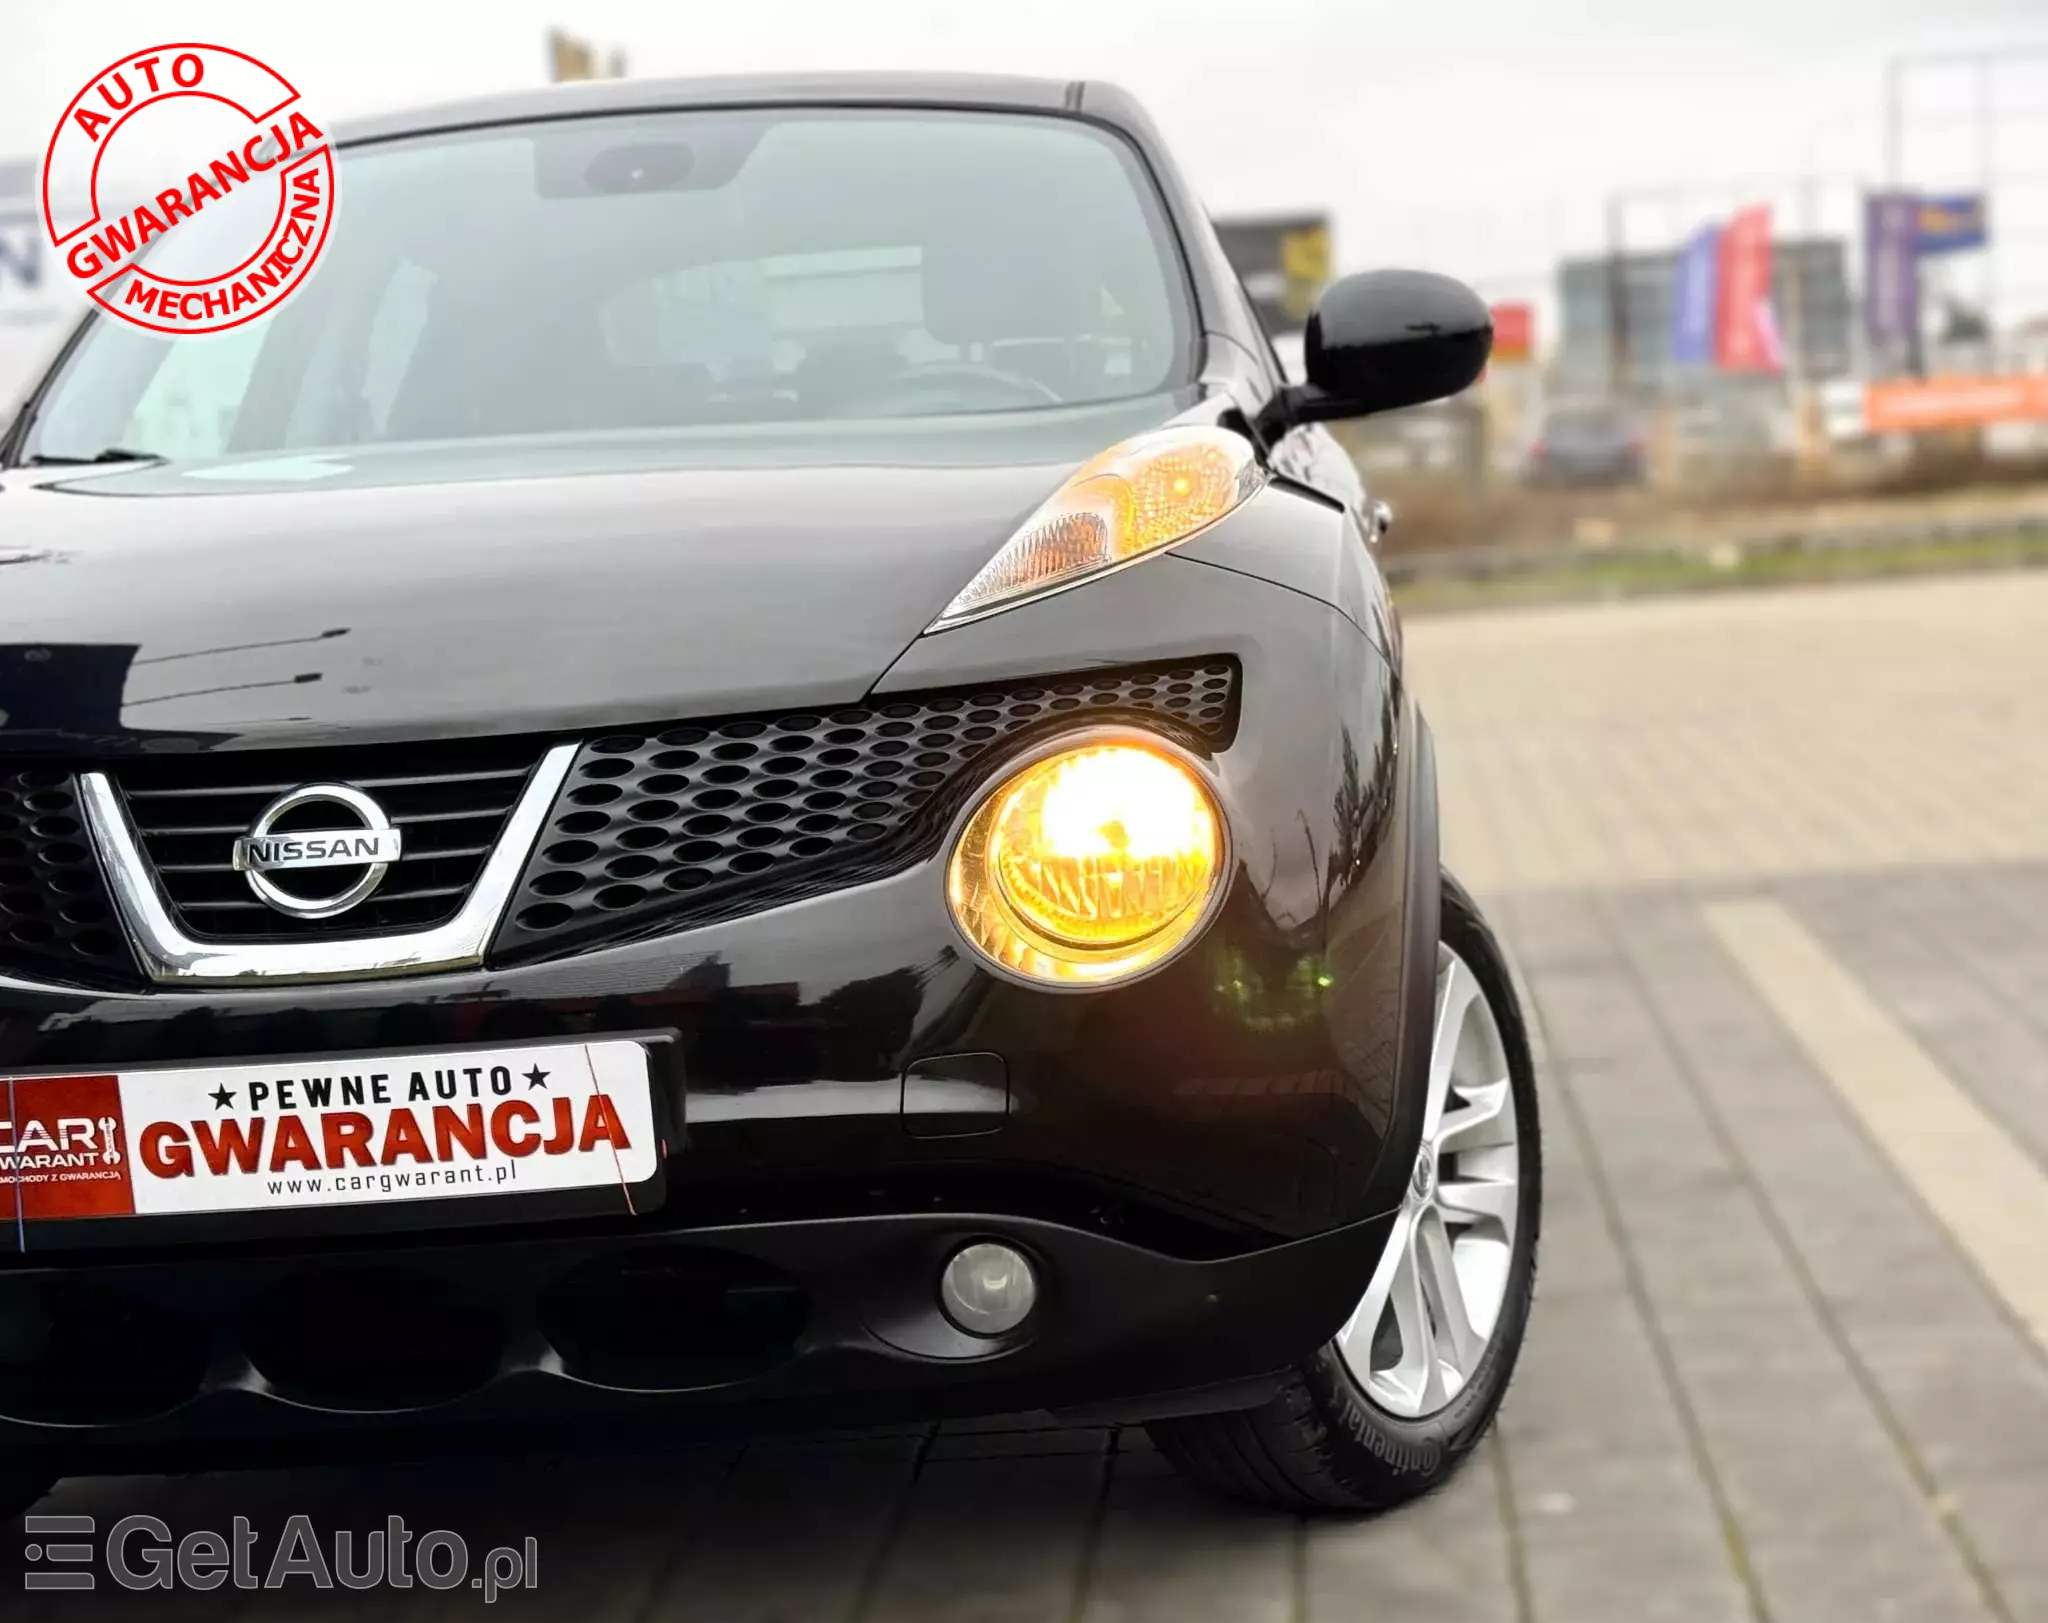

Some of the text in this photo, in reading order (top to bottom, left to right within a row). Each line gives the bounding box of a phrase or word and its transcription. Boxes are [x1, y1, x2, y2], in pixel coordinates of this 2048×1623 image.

[250, 837, 380, 862] NISSAN
[249, 1066, 512, 1111] PEWNE AUTO
[139, 1094, 632, 1179] GWARANCJA
[51, 1173, 59, 1182] Z
[267, 1160, 516, 1194] www.cargwarant.pl
[1338, 1399, 1441, 1477] Continental
